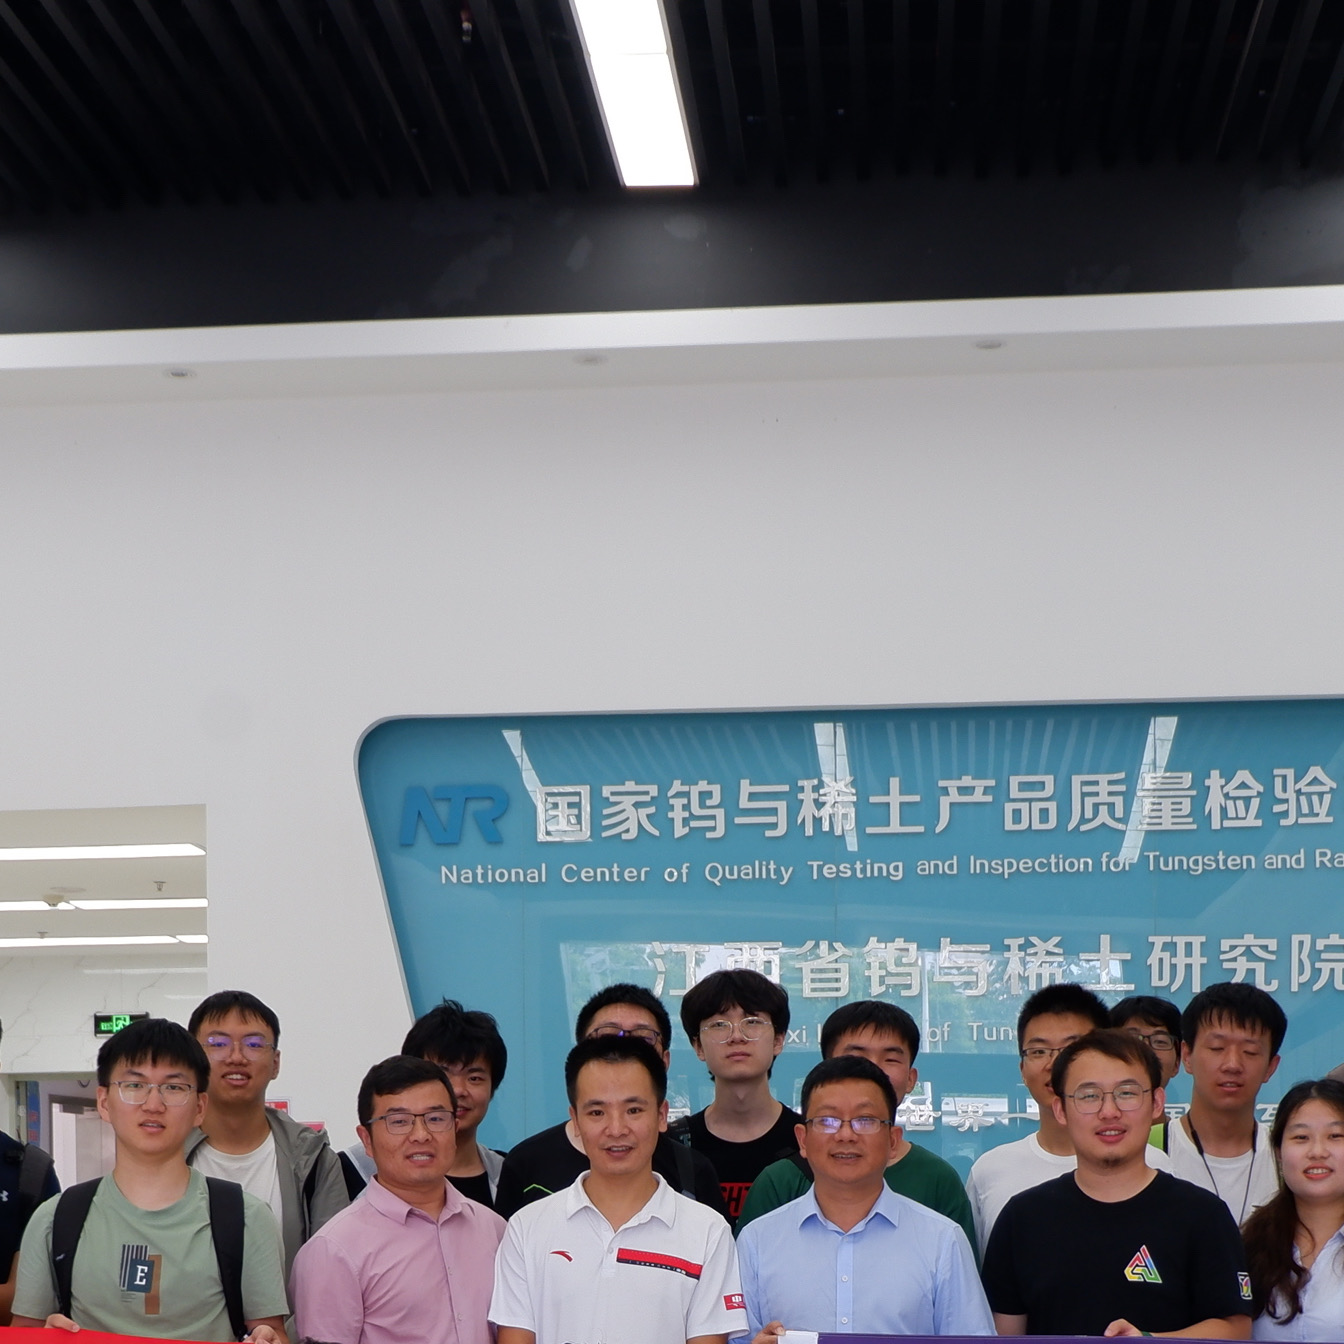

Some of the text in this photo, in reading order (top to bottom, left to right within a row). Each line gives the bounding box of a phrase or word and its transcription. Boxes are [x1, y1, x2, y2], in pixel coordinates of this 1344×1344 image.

[441, 863, 546, 885] National
[561, 862, 650, 883] Center
[664, 862, 689, 883] of
[705, 859, 793, 885] Quality
[807, 858, 903, 883] Testing
[917, 854, 957, 875] and
[969, 852, 1093, 879] Inspection
[1101, 851, 1137, 872] for
[1144, 850, 1256, 876] Tungsten
[1265, 849, 1305, 870] and
[927, 1022, 950, 1043] of
[134, 1265, 148, 1285] E
